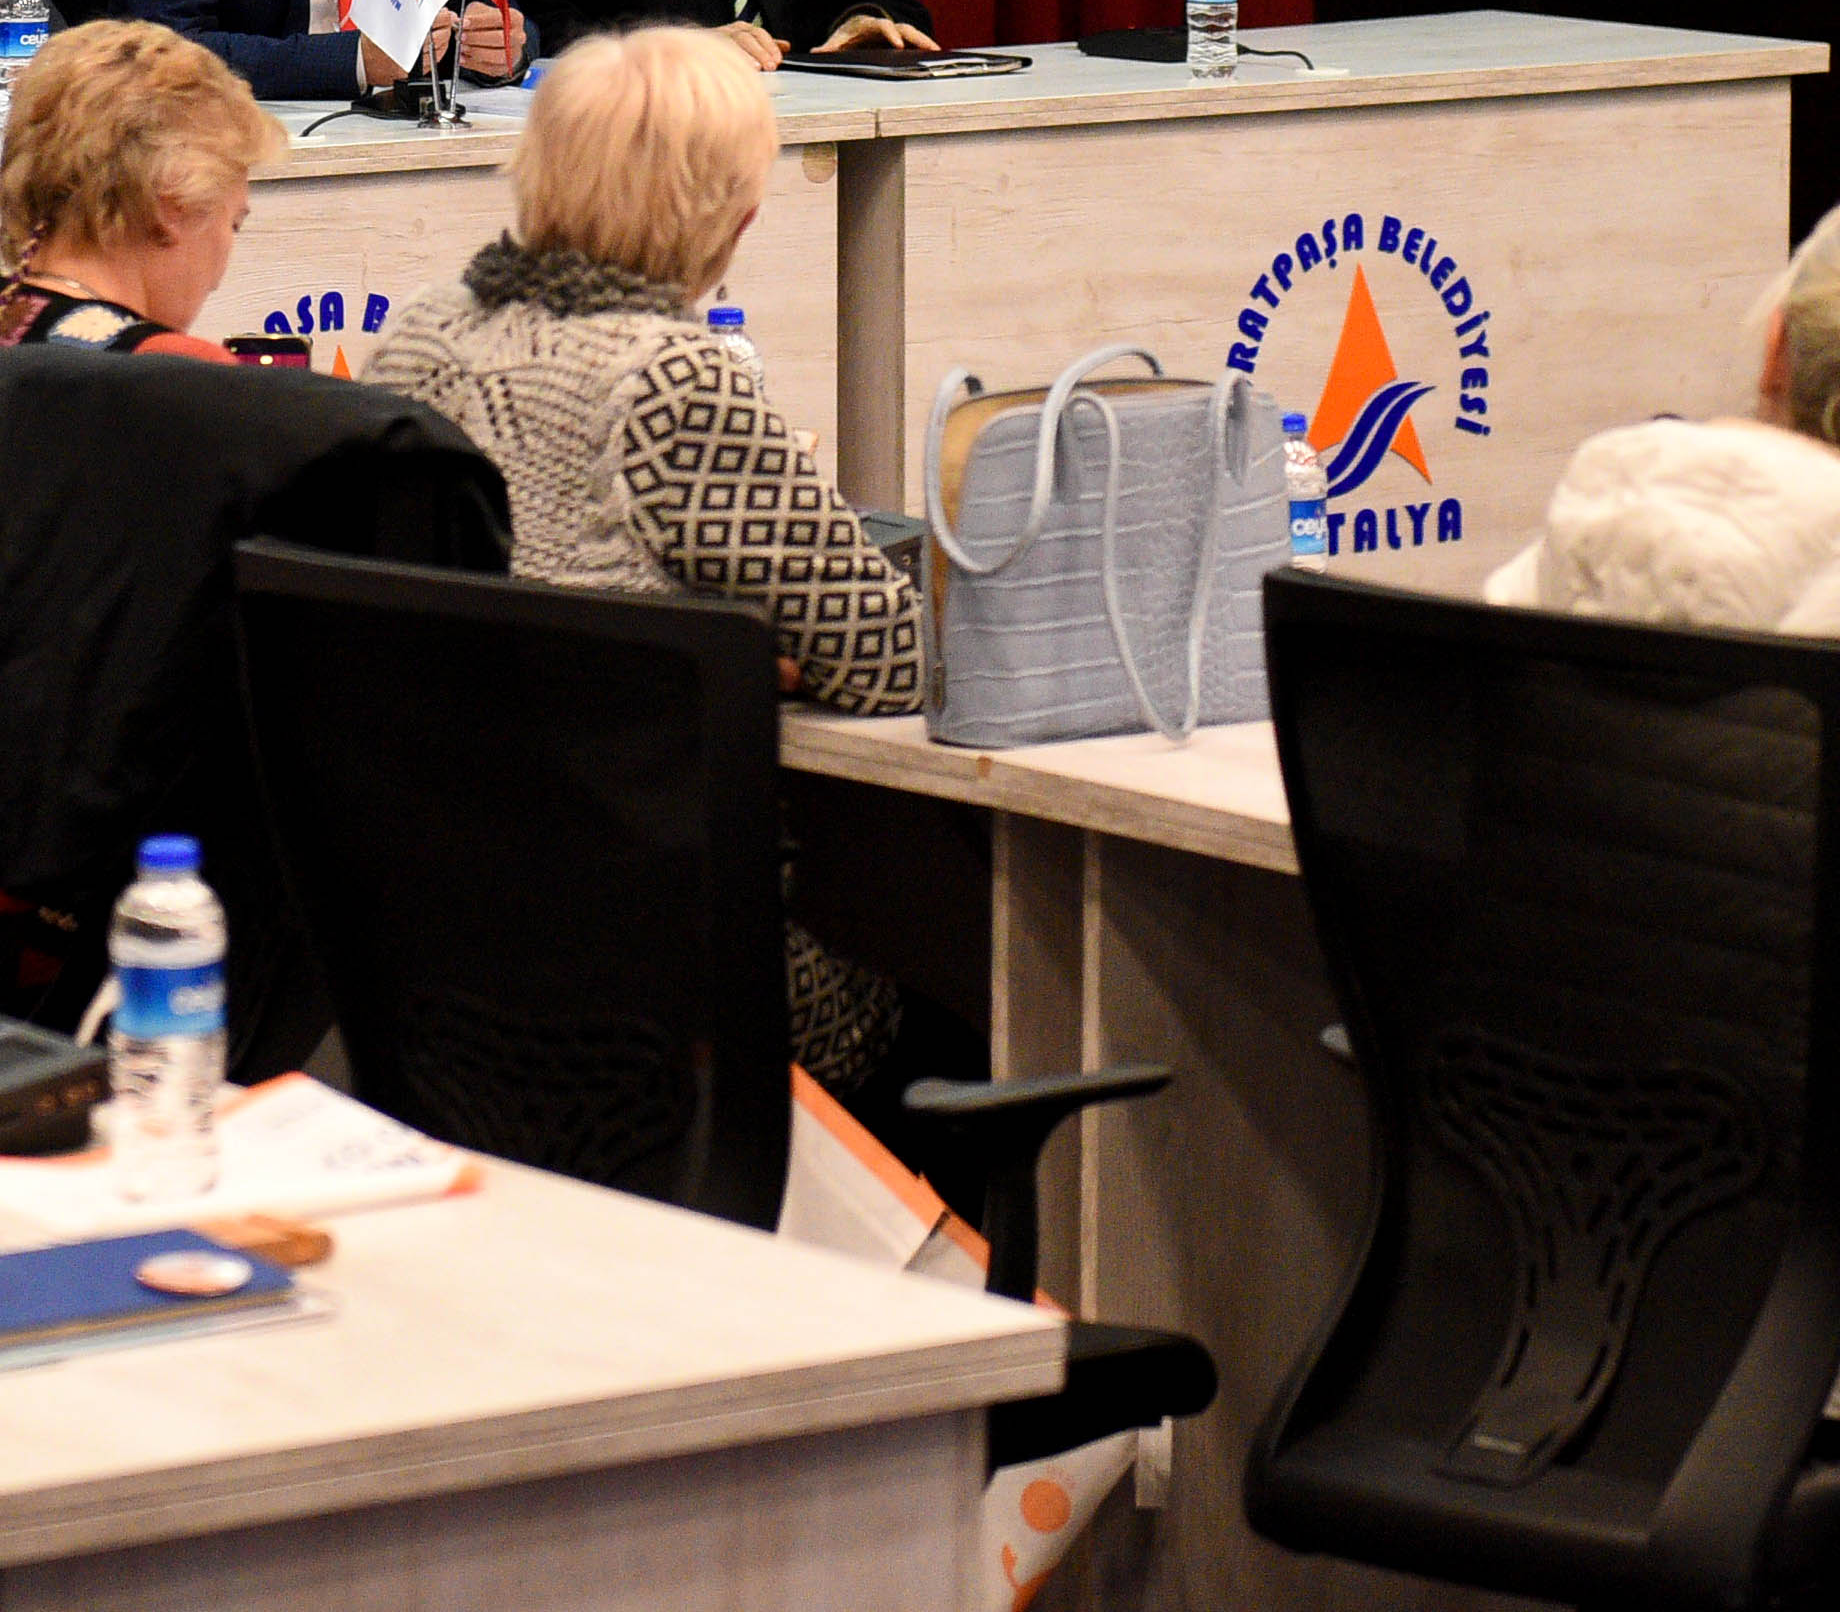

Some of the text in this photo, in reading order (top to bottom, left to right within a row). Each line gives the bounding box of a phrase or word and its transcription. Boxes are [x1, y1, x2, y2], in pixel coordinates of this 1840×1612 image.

[1226, 212, 1491, 436] RATPAŞA BELEDİYESİ
[1327, 498, 1463, 556] TALYA
